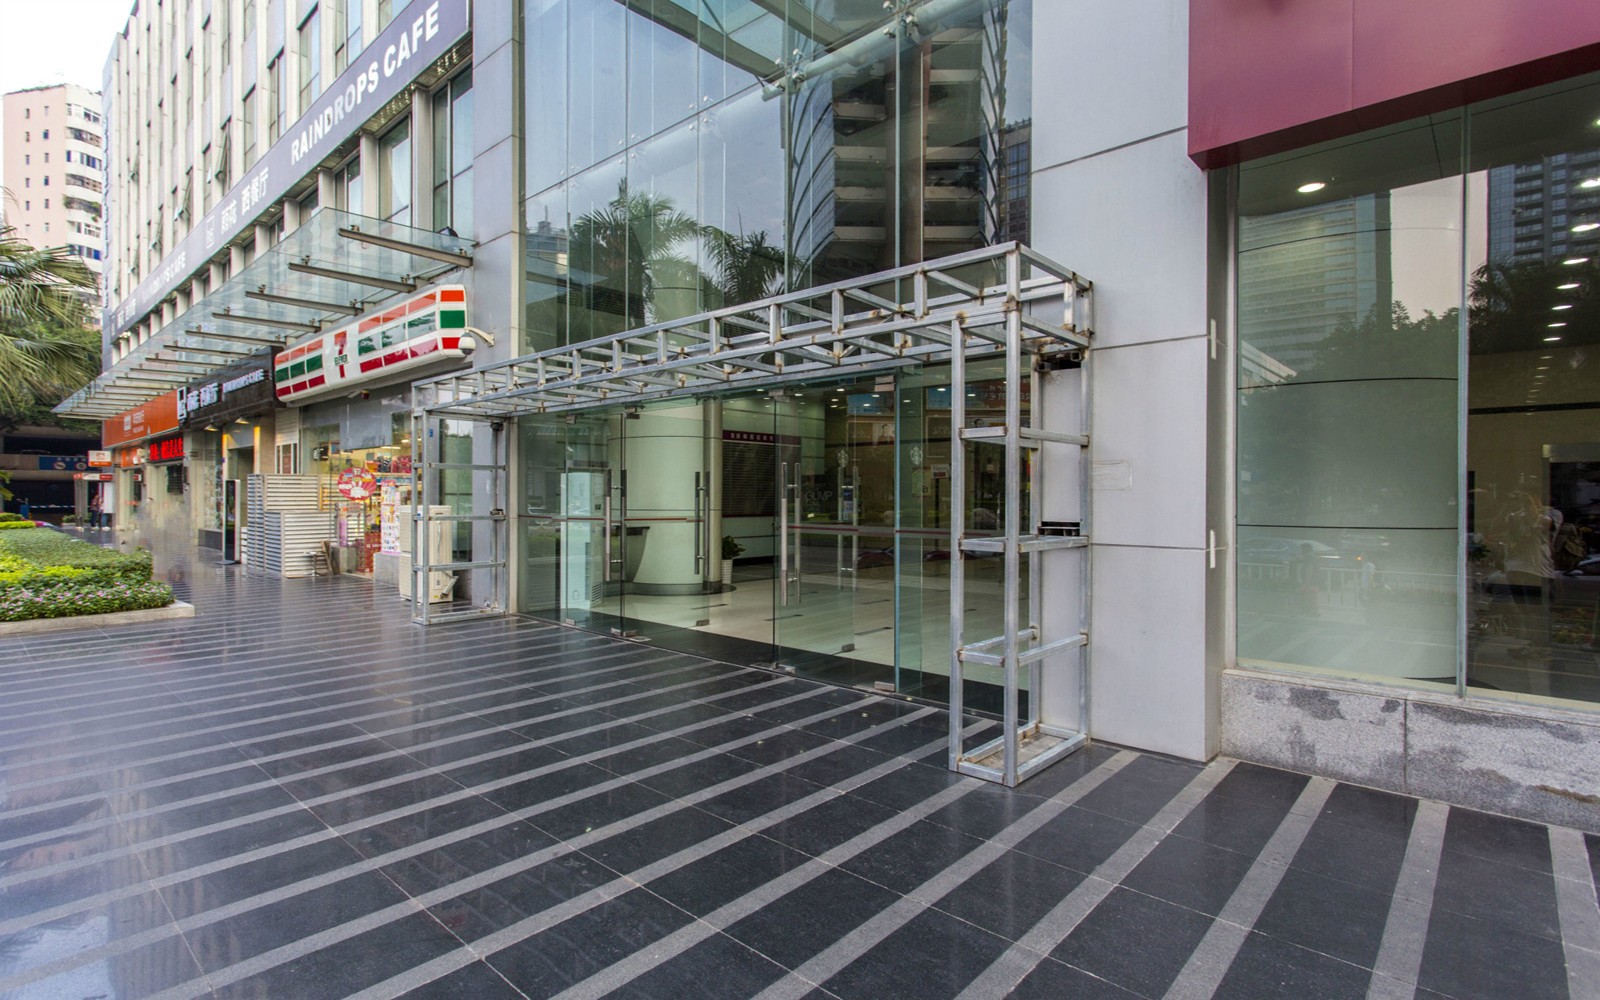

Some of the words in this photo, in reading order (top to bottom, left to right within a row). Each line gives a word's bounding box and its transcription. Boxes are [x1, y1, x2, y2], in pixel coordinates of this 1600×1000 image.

[291, 61, 379, 165] RAINDROPS
[384, 1, 439, 78] CAFE
[334, 330, 347, 379] 7
